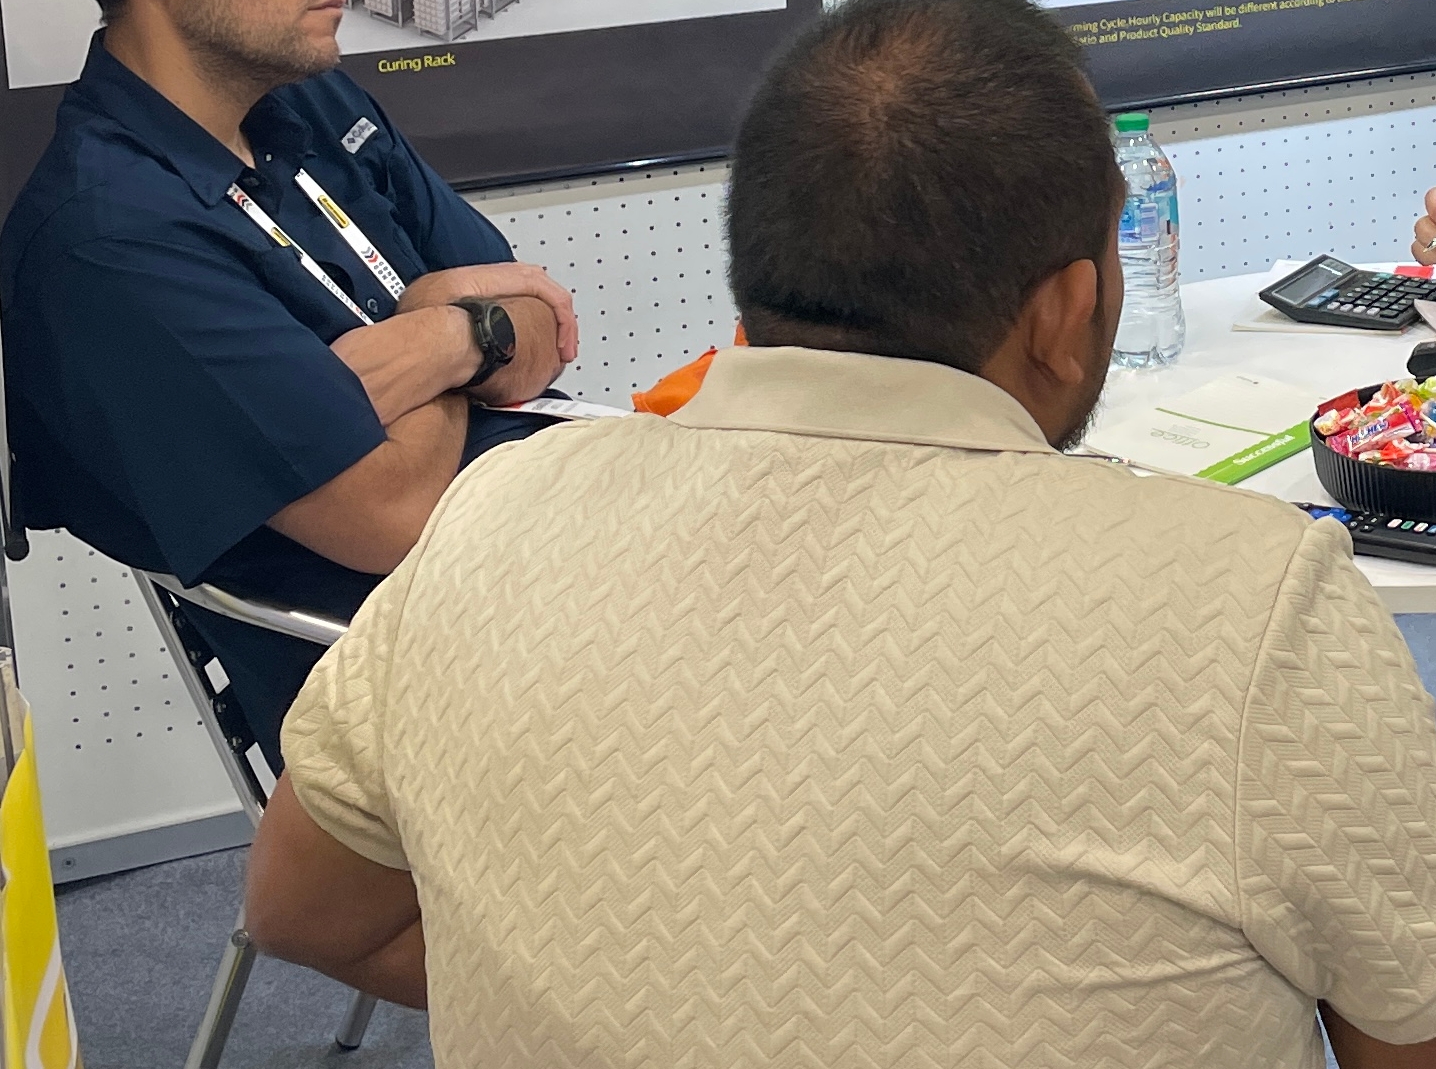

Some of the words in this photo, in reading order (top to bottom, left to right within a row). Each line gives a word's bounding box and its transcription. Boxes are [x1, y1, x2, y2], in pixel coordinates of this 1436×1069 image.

[1163, 9, 1206, 23] Capacity
[378, 57, 422, 73] Curing
[424, 52, 456, 68] Rack
